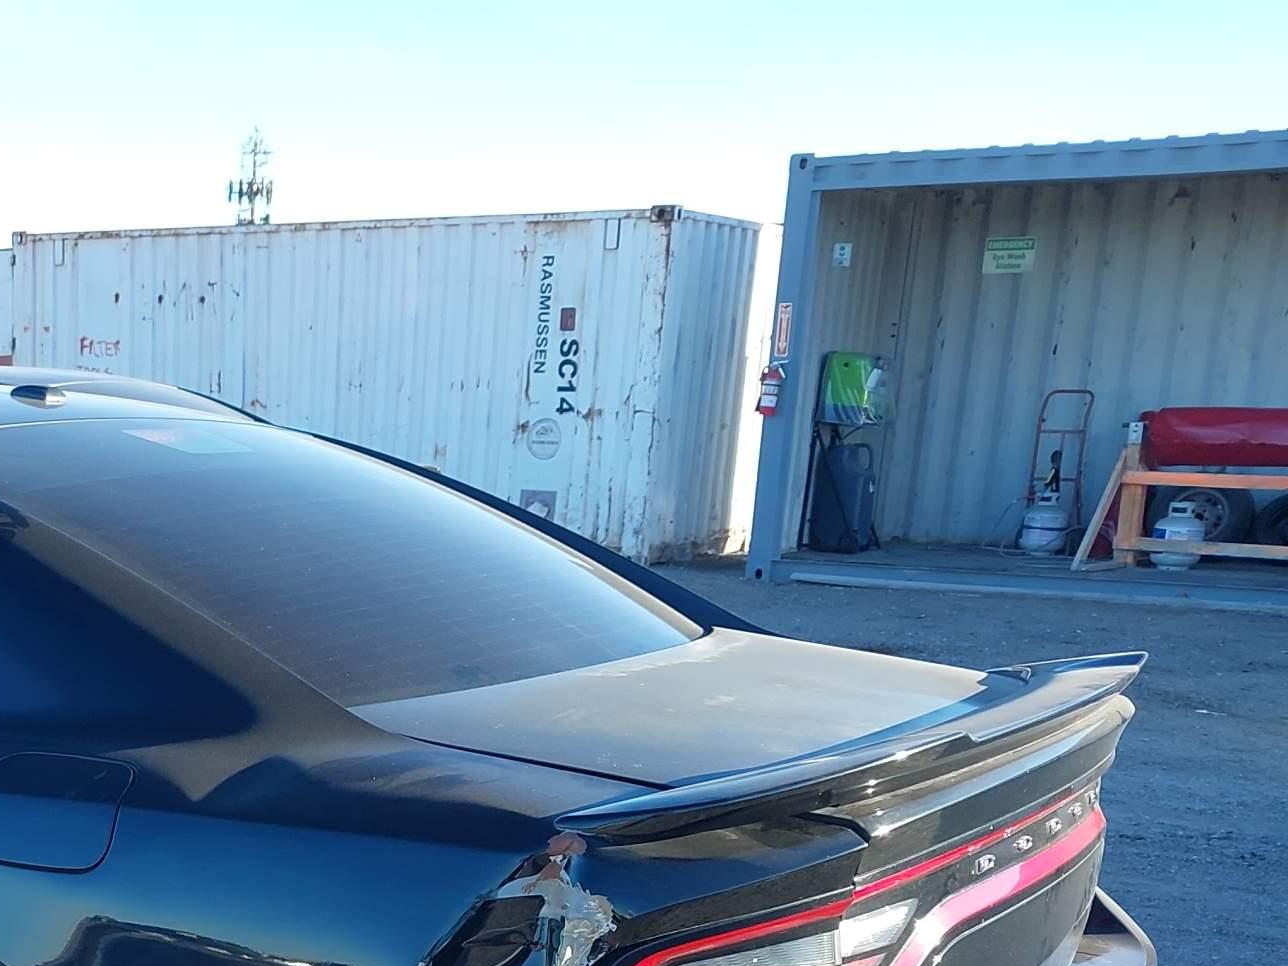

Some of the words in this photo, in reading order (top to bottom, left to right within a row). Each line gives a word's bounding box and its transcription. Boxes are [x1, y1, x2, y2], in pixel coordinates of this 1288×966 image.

[79, 336, 120, 358] FILTER
[533, 255, 555, 374] RASMUSSEN
[555, 338, 580, 415] SC14
